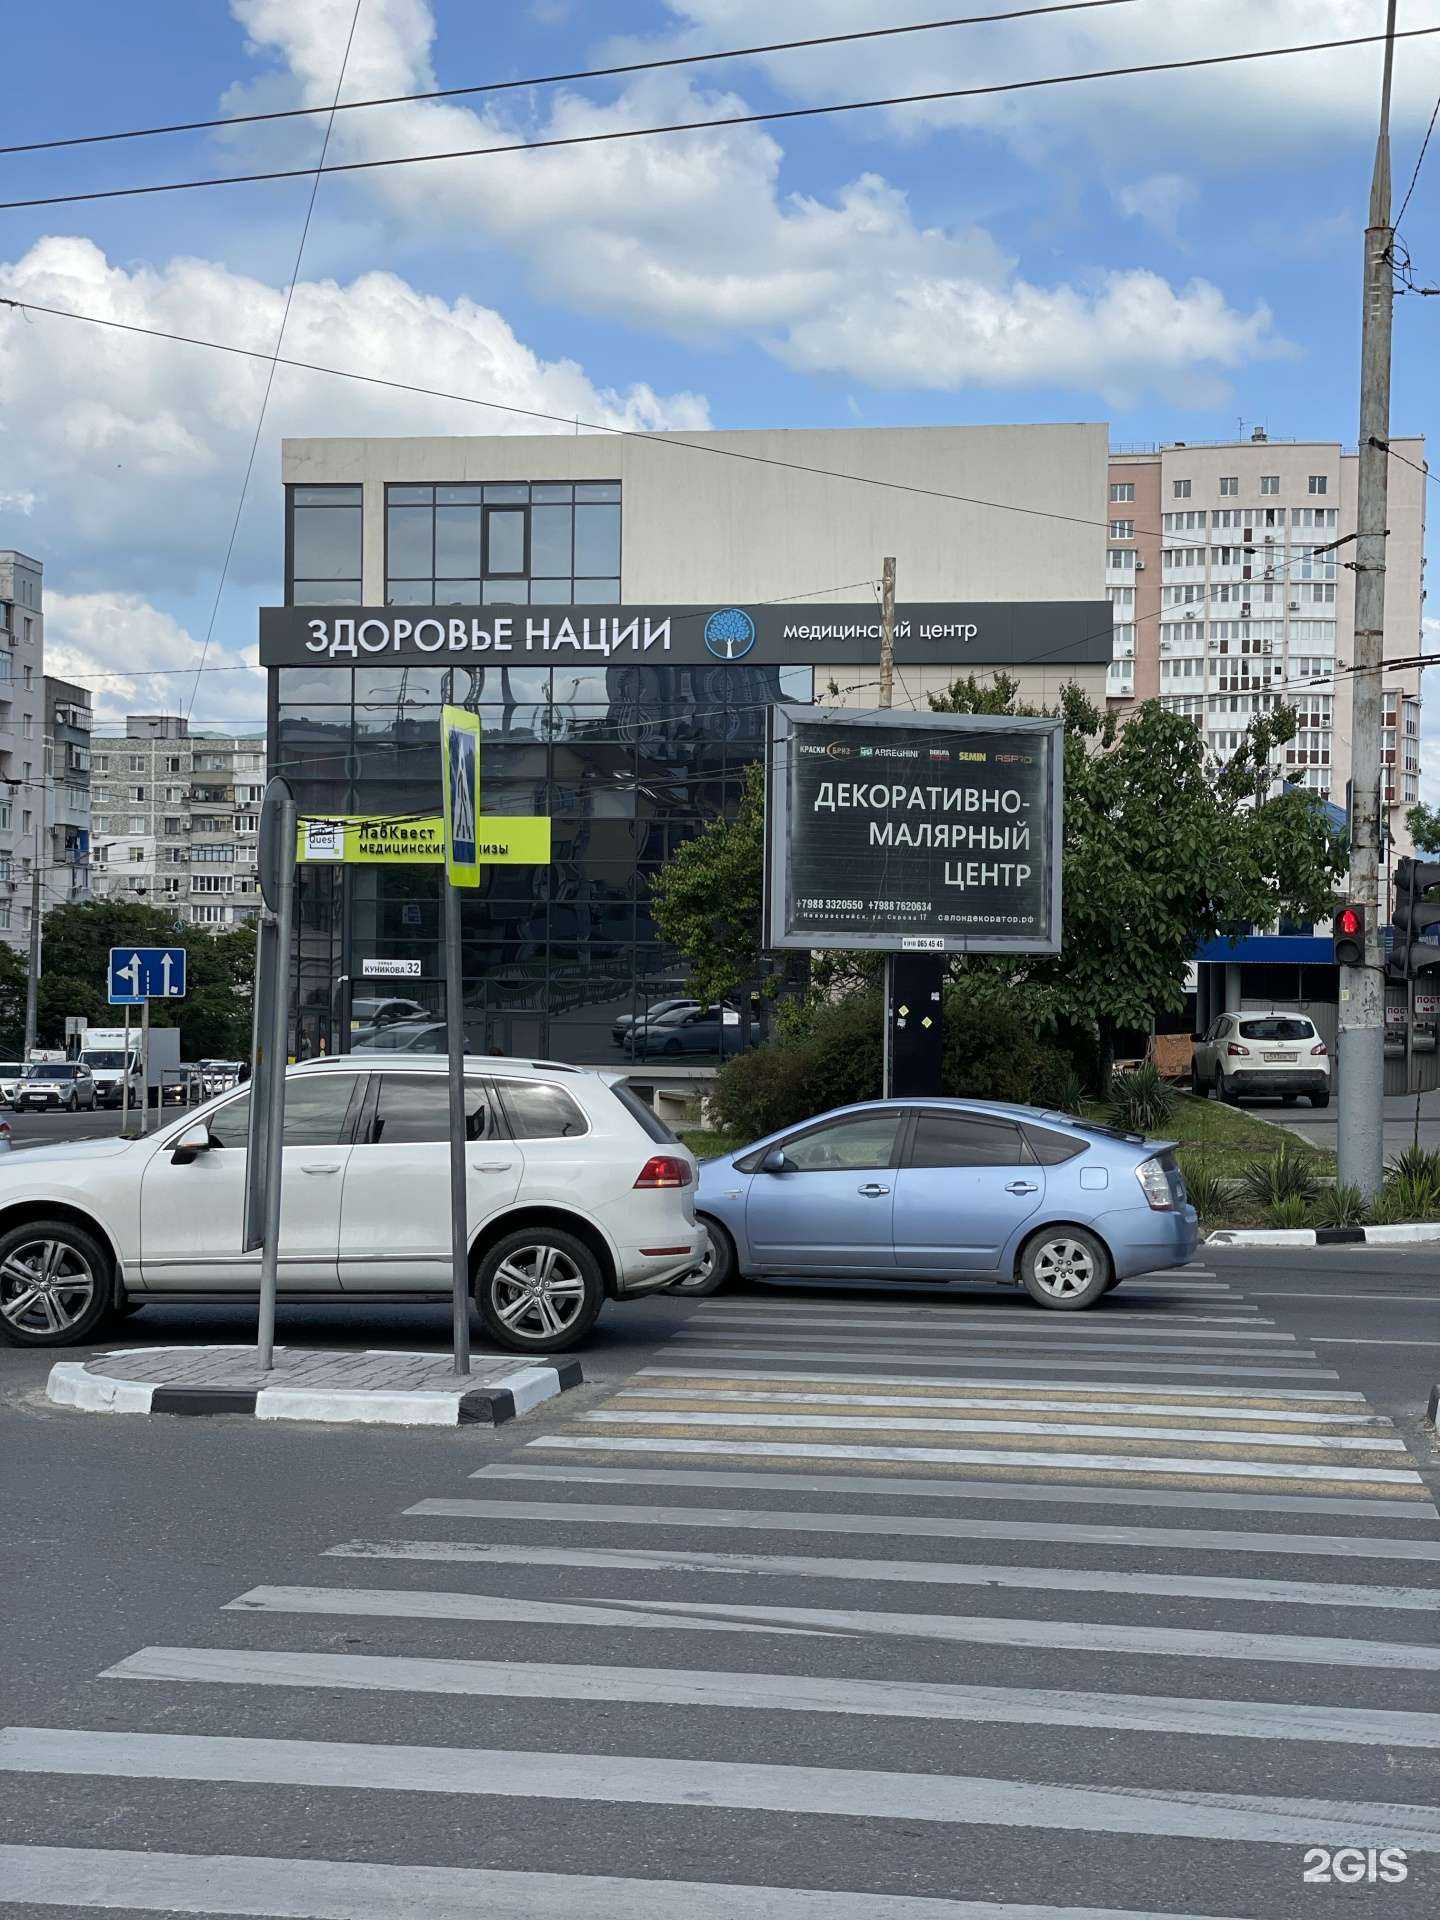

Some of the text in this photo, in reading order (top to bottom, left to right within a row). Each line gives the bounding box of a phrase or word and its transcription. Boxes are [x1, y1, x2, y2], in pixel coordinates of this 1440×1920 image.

[305, 617, 672, 657] ЗДОРОВЬЕ НАЦИИ
[783, 621, 978, 642] медицинсий центр
[799, 745, 826, 754] КРАСКИ
[874, 748, 919, 759] ARREGHINI
[958, 751, 987, 762] SEMIN
[814, 782, 1031, 814] ДЕКОРАТИВНО-
[358, 823, 435, 840] ЛабКвест
[869, 820, 1031, 851] МАЛЯРНЫЙ
[943, 861, 1032, 891] ЦЕНТР
[796, 898, 932, 912] +7988 3320550 +7988 7620634
[937, 913, 1034, 924] салондекоратор.рф
[364, 962, 420, 974] КУНИКОВА 32
[1417, 996, 1440, 1004] ПОСТ
